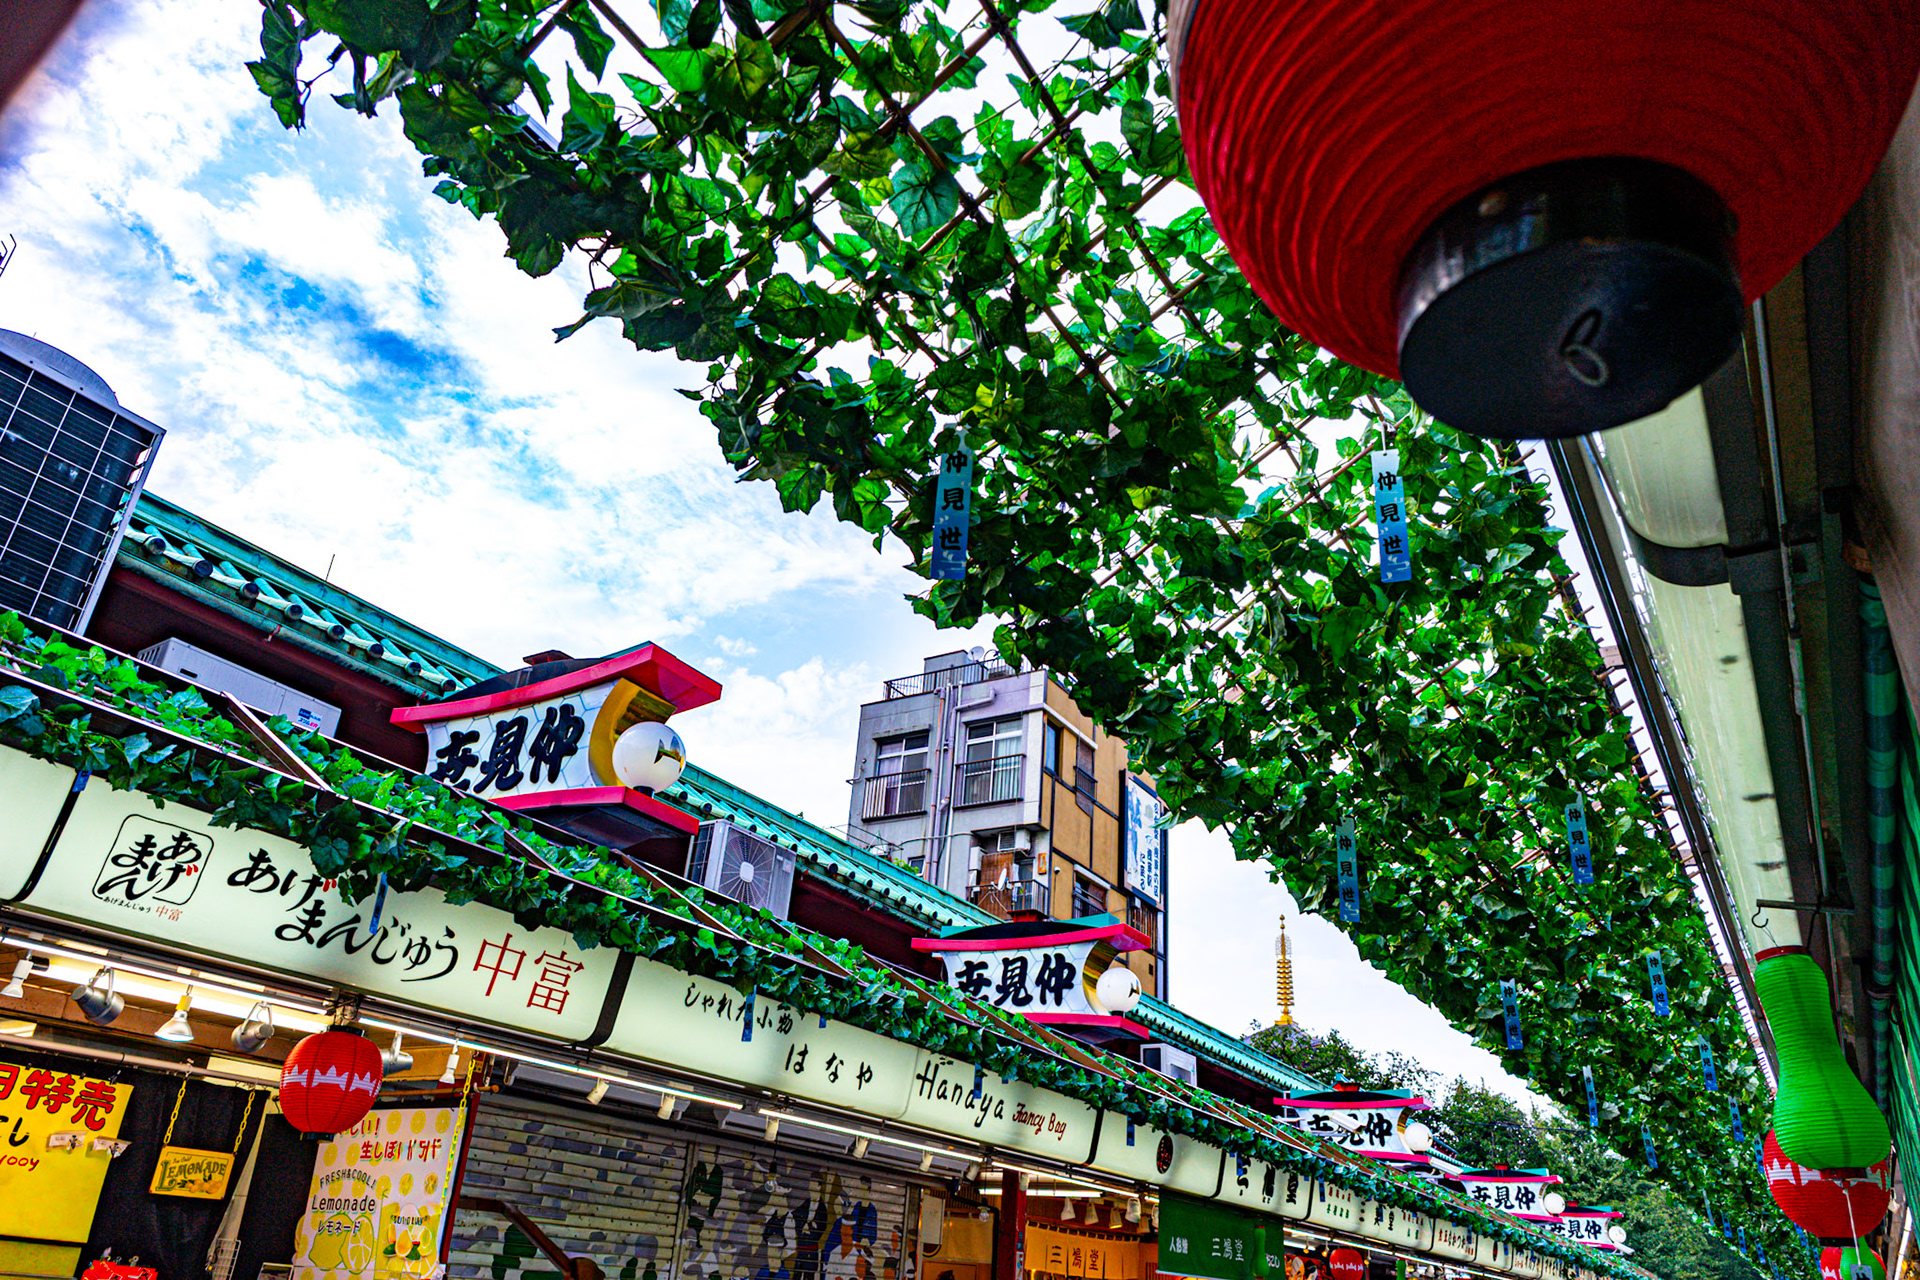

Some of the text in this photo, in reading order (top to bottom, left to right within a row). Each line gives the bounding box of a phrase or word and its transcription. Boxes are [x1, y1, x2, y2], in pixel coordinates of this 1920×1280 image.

[938, 450, 968, 551] 仲見世
[1377, 471, 1404, 555] 仲見世
[1567, 808, 1589, 868] 仲見世
[1338, 834, 1356, 903] 仲見世
[274, 899, 460, 983] まんじゅう
[472, 932, 586, 1016] 中富
[1503, 985, 1520, 1036] 仲見世
[784, 1043, 874, 1091] はなや
[916, 1059, 1004, 1128] Hanaya
[1012, 1102, 1046, 1136] Fancy
[155, 1157, 227, 1192] LEMONADE
[319, 1168, 377, 1190] FRESH&COOL!
[311, 1195, 377, 1212] Lemonade
[317, 1218, 361, 1236] レモネード
